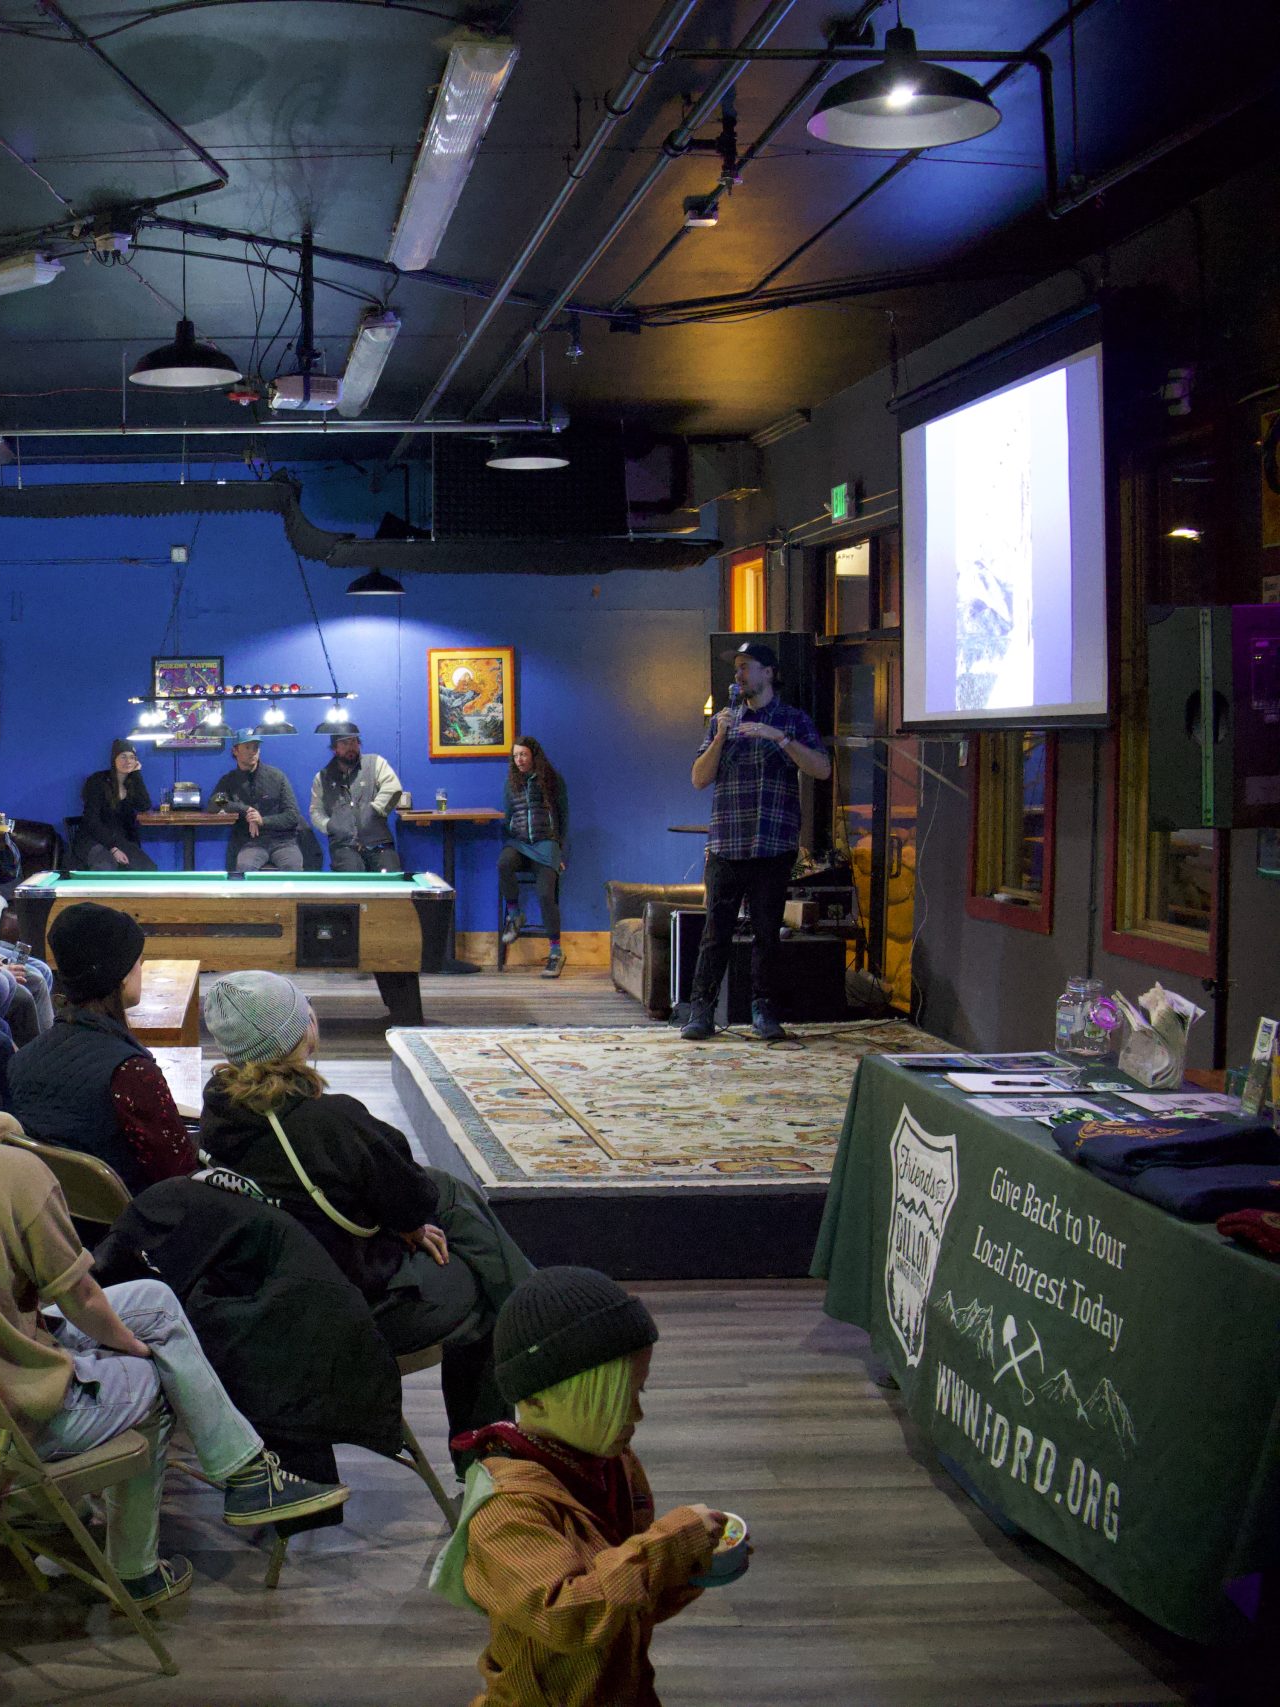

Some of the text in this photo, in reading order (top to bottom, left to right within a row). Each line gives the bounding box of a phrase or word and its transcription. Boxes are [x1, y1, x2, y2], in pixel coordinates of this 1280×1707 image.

[899, 1144, 936, 1199] Friends
[990, 1166, 1126, 1270] Give Back to Your
[895, 1211, 931, 1279] DILLON
[972, 1225, 1124, 1352] Local Forest Today
[935, 1360, 1121, 1544] WWW.FDRD.ORG
